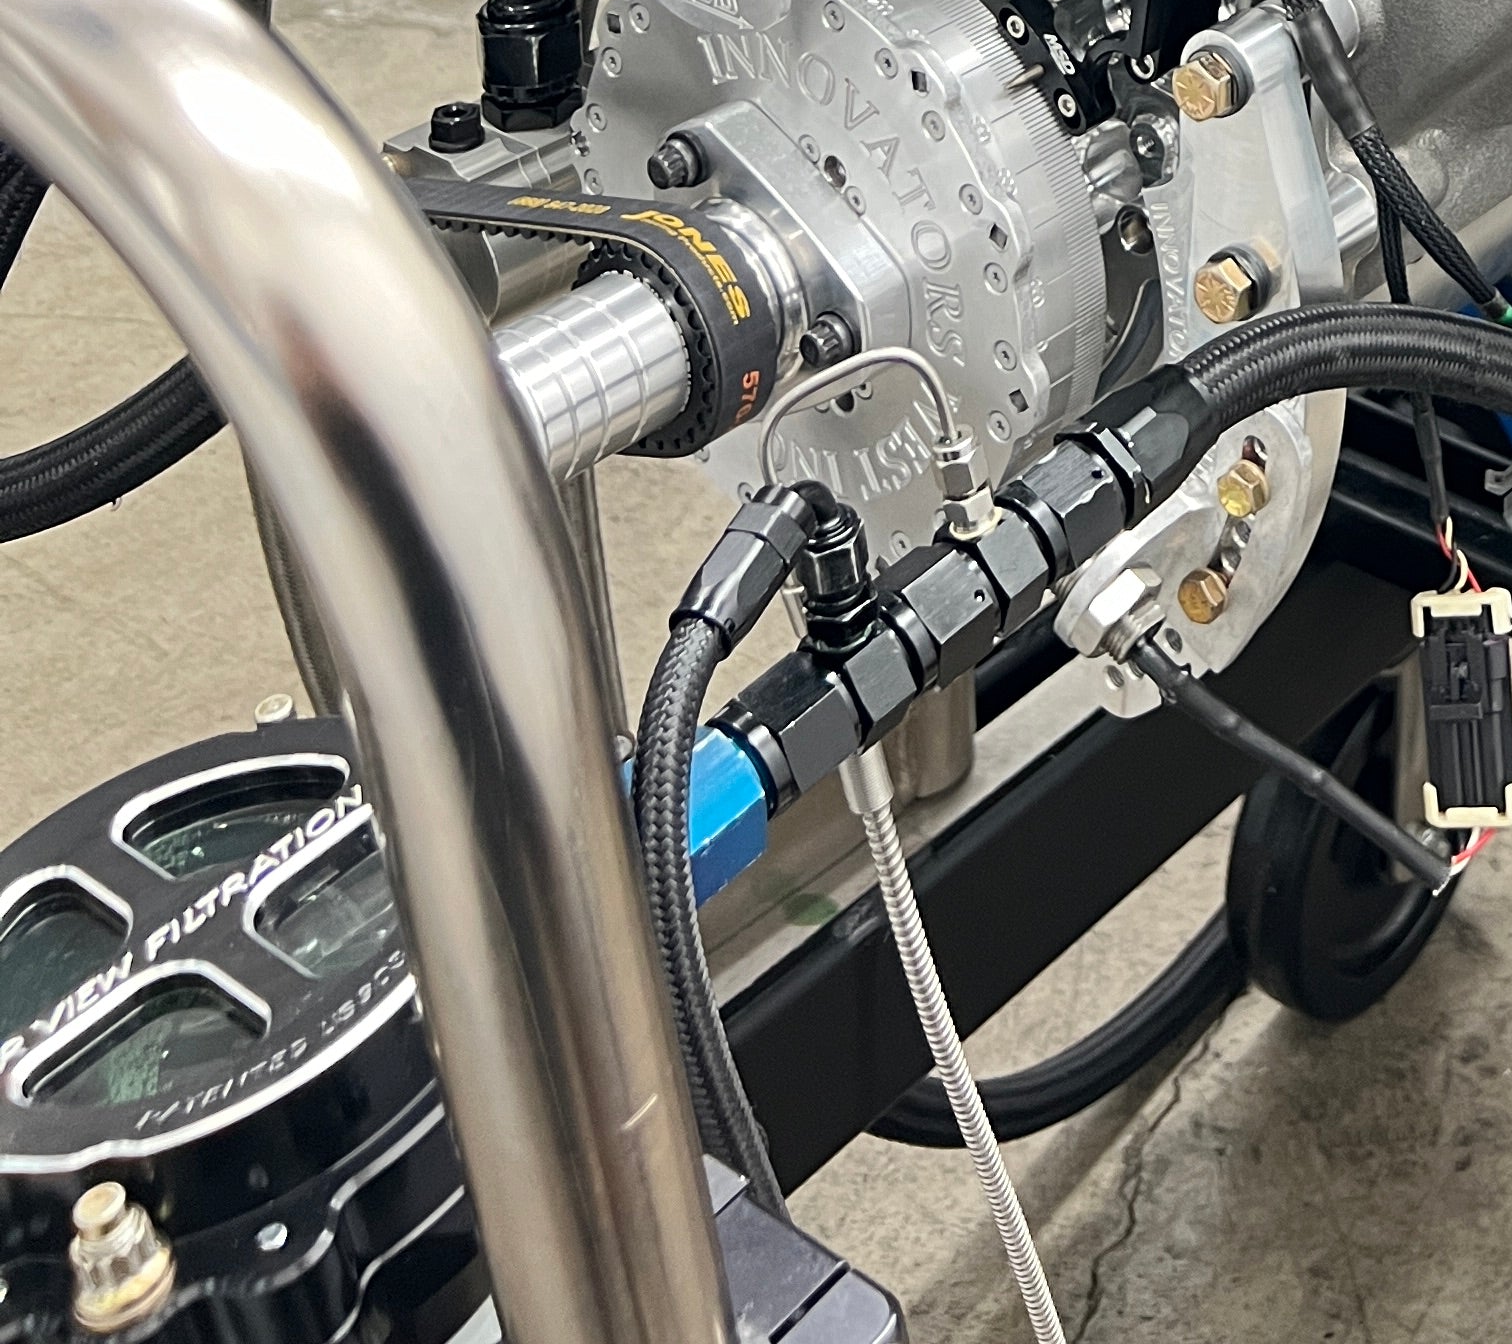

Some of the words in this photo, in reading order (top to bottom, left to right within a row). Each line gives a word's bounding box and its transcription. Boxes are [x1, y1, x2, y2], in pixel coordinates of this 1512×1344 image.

[620, 210, 751, 319] JONES
[697, 33, 967, 368] INNOVATORS
[1149, 201, 1189, 359] INNOVATO
[29, 950, 133, 1033] VIEW
[143, 784, 364, 963] FILTRATION
